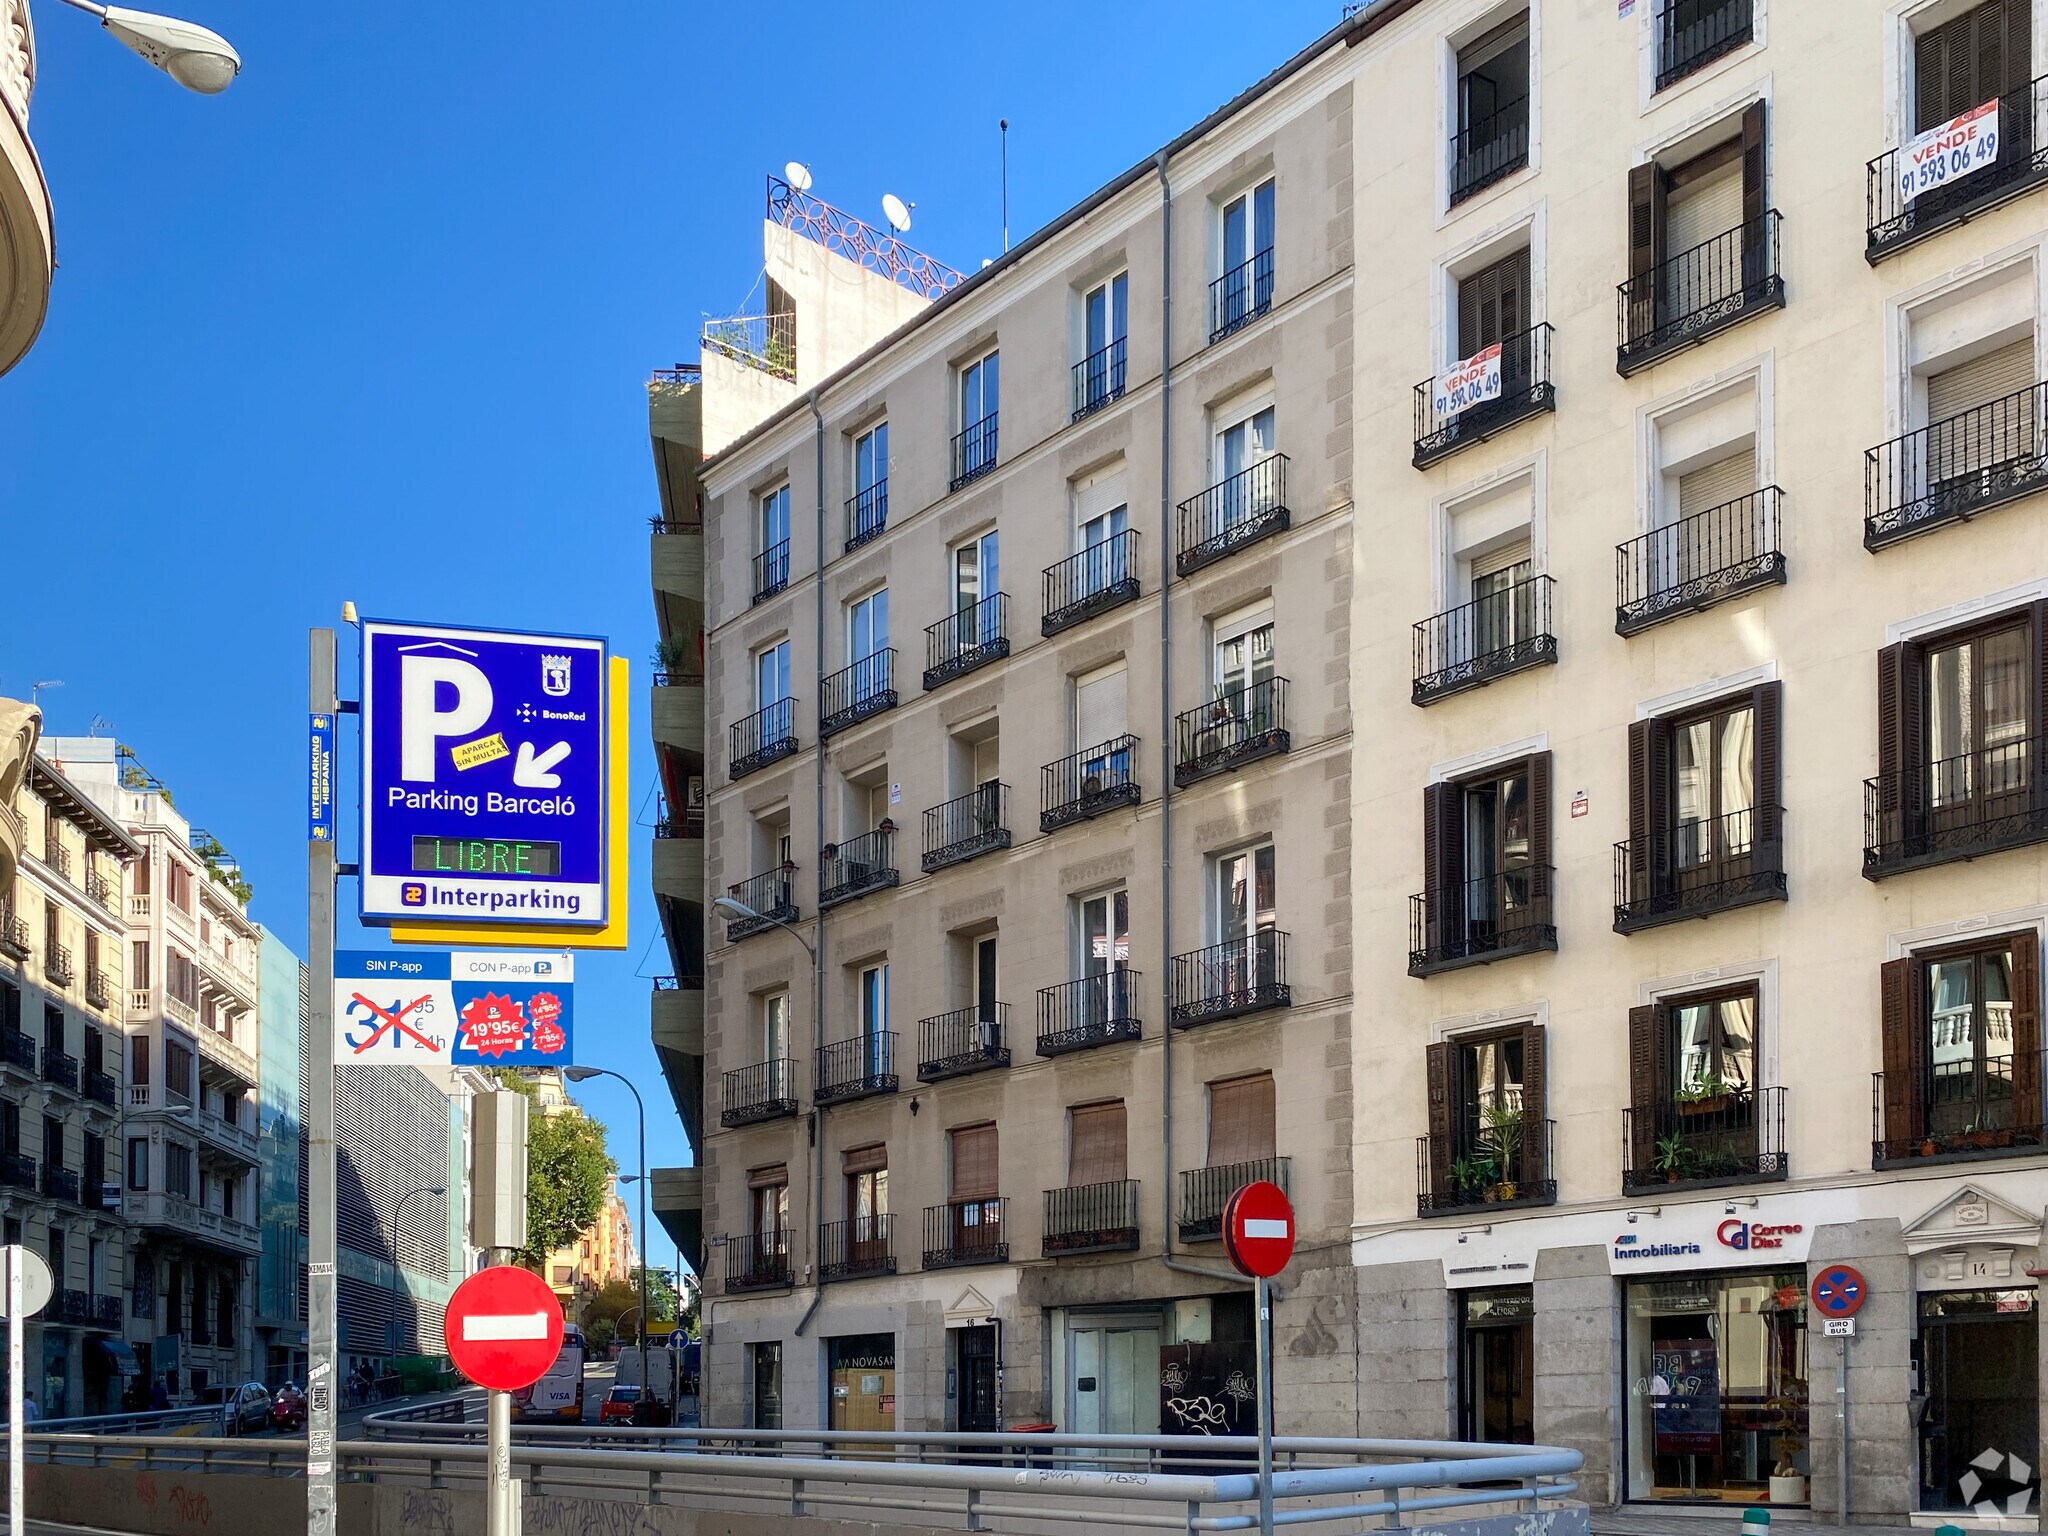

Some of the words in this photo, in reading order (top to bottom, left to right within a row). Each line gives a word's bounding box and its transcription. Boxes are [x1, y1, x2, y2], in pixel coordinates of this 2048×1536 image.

[1913, 125, 1977, 164] VENDE
[1902, 171, 1915, 197] 91
[1920, 155, 1946, 187] 593
[1951, 144, 1970, 173] 06
[1976, 133, 1996, 160] 49
[1445, 365, 1487, 392] VENDE
[1436, 397, 1447, 416] 91
[1469, 379, 1482, 401] 06
[1485, 372, 1499, 394] 49
[401, 655, 493, 782] P
[542, 709, 586, 721] BonoRed
[462, 740, 496, 756] APARCA
[456, 757, 472, 767] SIN
[311, 735, 320, 819] INTERPARKING
[322, 751, 330, 805] HISPANIA
[388, 787, 478, 816] Parking
[487, 791, 575, 816] Barceló
[436, 840, 532, 874] LIBRE
[432, 886, 580, 913] Interparking
[366, 960, 387, 971] SIN
[390, 961, 423, 973] P-app
[469, 962, 496, 972] CON
[500, 963, 531, 975] P-app
[344, 999, 401, 1049] 31
[414, 1017, 424, 1030] €
[470, 1020, 520, 1037] 19'95€
[1751, 1223, 1803, 1236] Correo
[1614, 1242, 1701, 1260] Inmobiliaria
[1973, 1263, 1986, 1275] 14
[966, 1318, 975, 1327] 16
[1829, 1321, 1849, 1329] GIRO
[550, 1392, 570, 1400] VISA
[320, 1431, 330, 1454] PABLO
